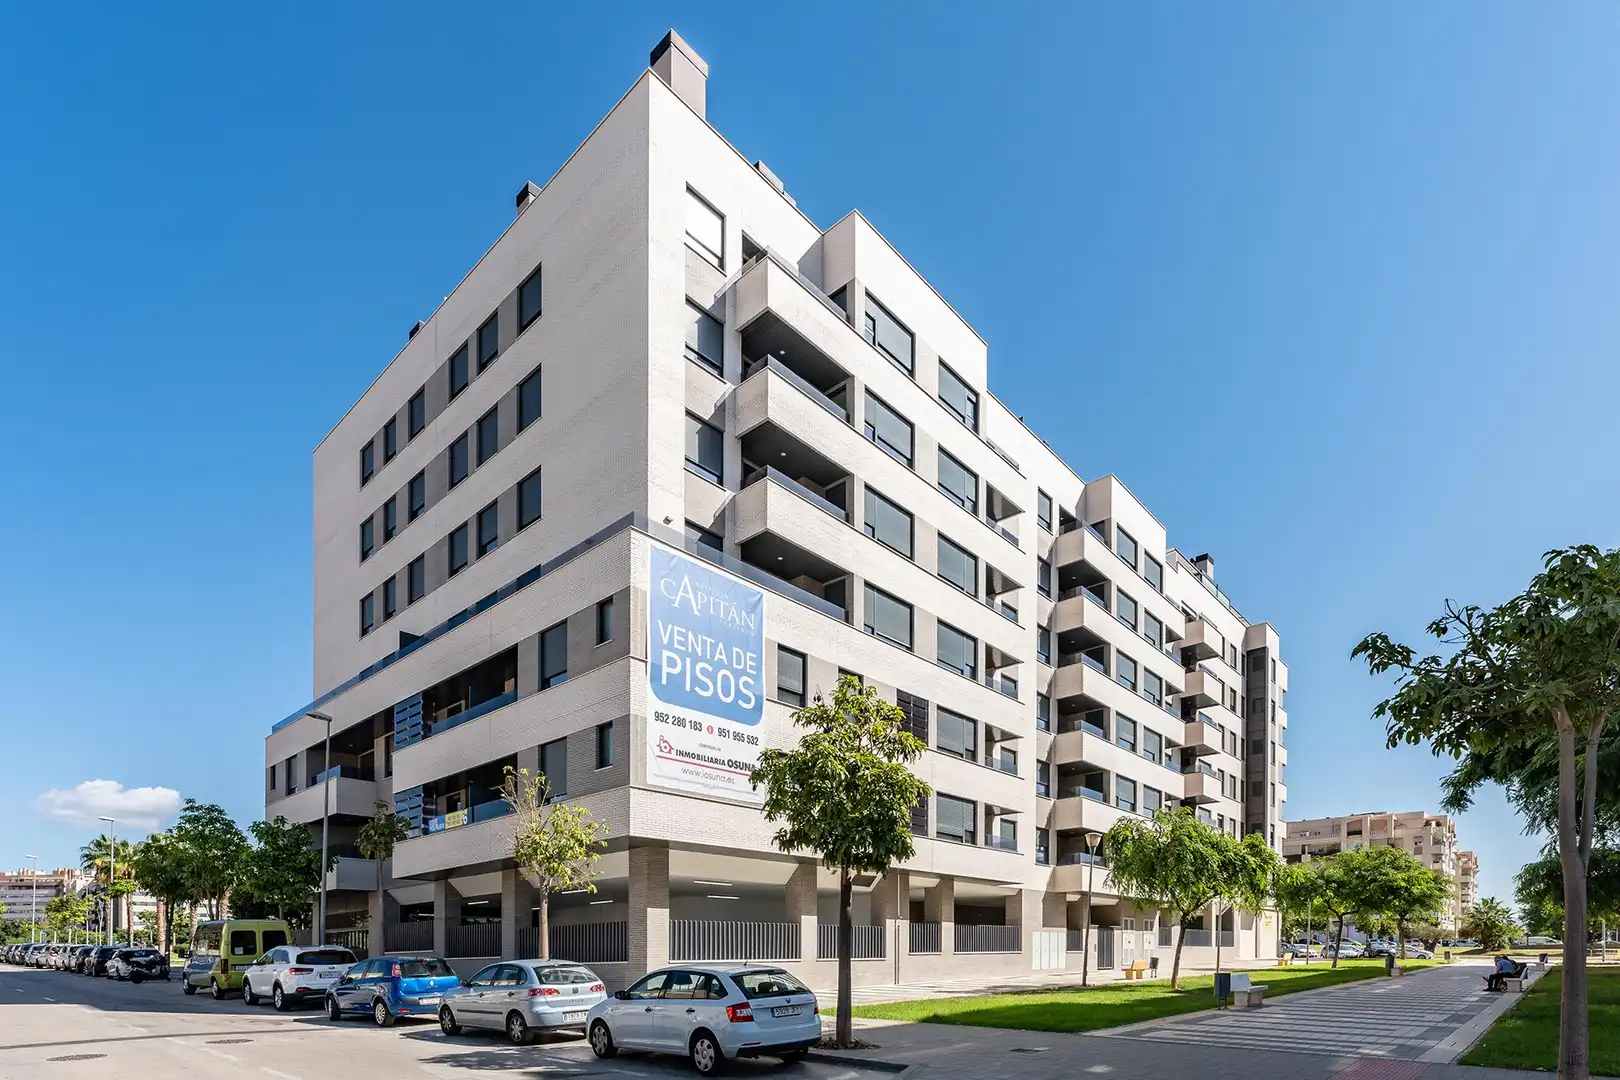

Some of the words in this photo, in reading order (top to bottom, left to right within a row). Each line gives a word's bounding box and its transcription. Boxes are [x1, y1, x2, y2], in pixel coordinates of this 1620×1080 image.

[657, 619, 728, 666] VENTA
[732, 646, 757, 675] DE
[661, 649, 756, 709] PISOS
[654, 711, 669, 724] 952
[672, 715, 687, 728] 280
[688, 719, 703, 732] 183
[717, 727, 731, 739] 951
[732, 730, 746, 743] 955
[746, 735, 759, 746] 532
[675, 748, 726, 766] INMOBILIARIA
